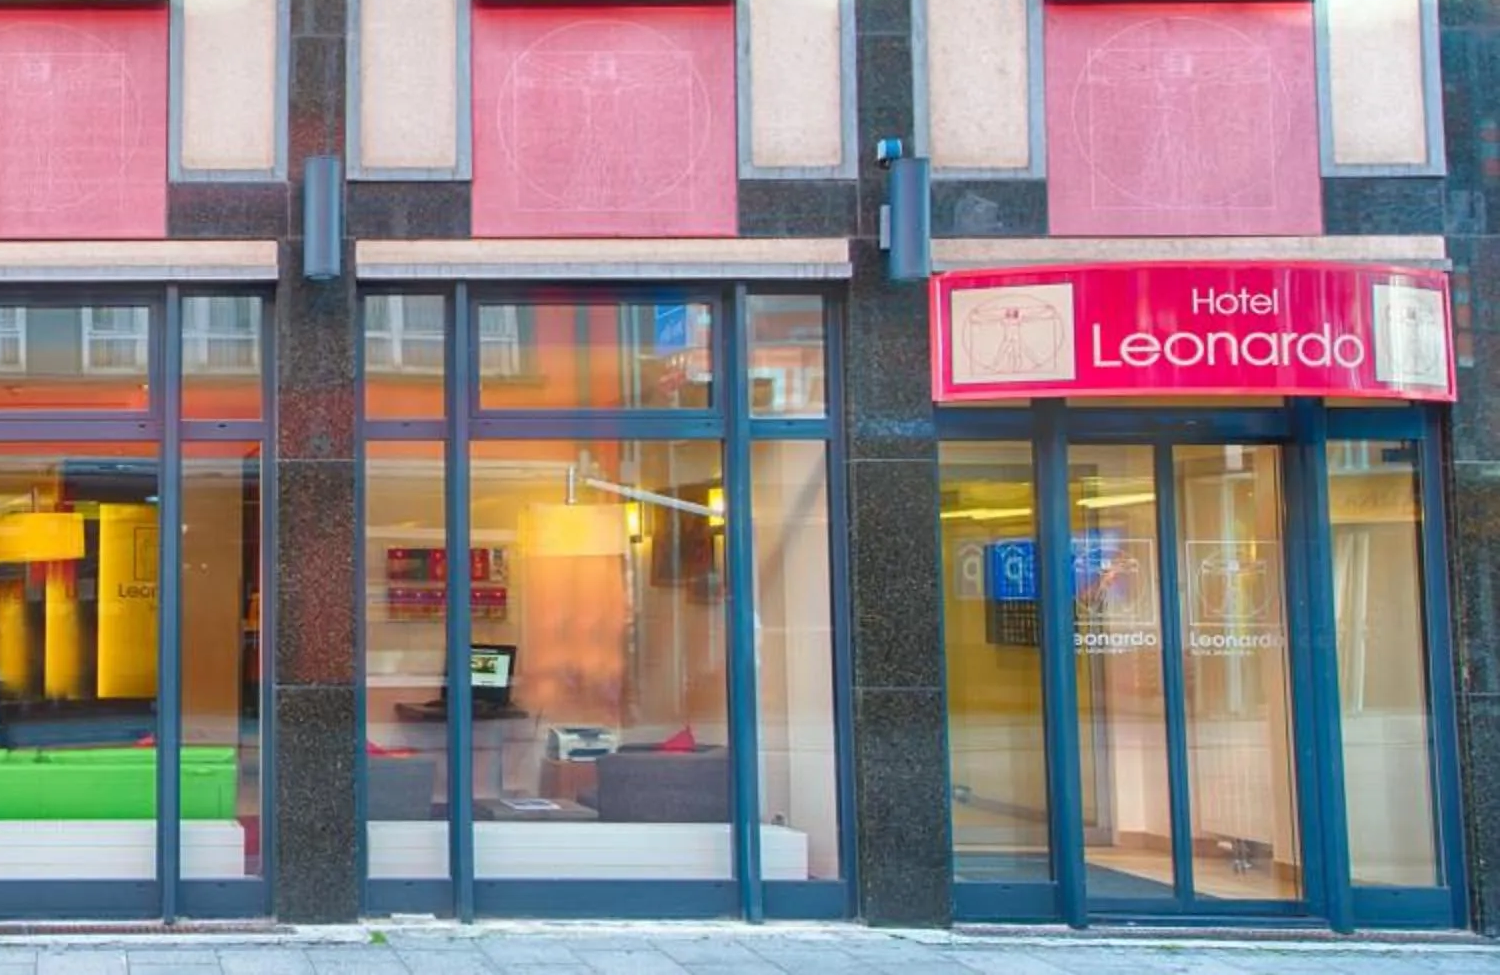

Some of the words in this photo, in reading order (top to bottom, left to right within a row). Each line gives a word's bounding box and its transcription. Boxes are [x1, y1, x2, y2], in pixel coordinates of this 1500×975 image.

[1191, 288, 1279, 315] Hotel
[1093, 322, 1365, 368] Leonardo
[118, 583, 155, 598] Leo
[1074, 631, 1157, 646] eonardo
